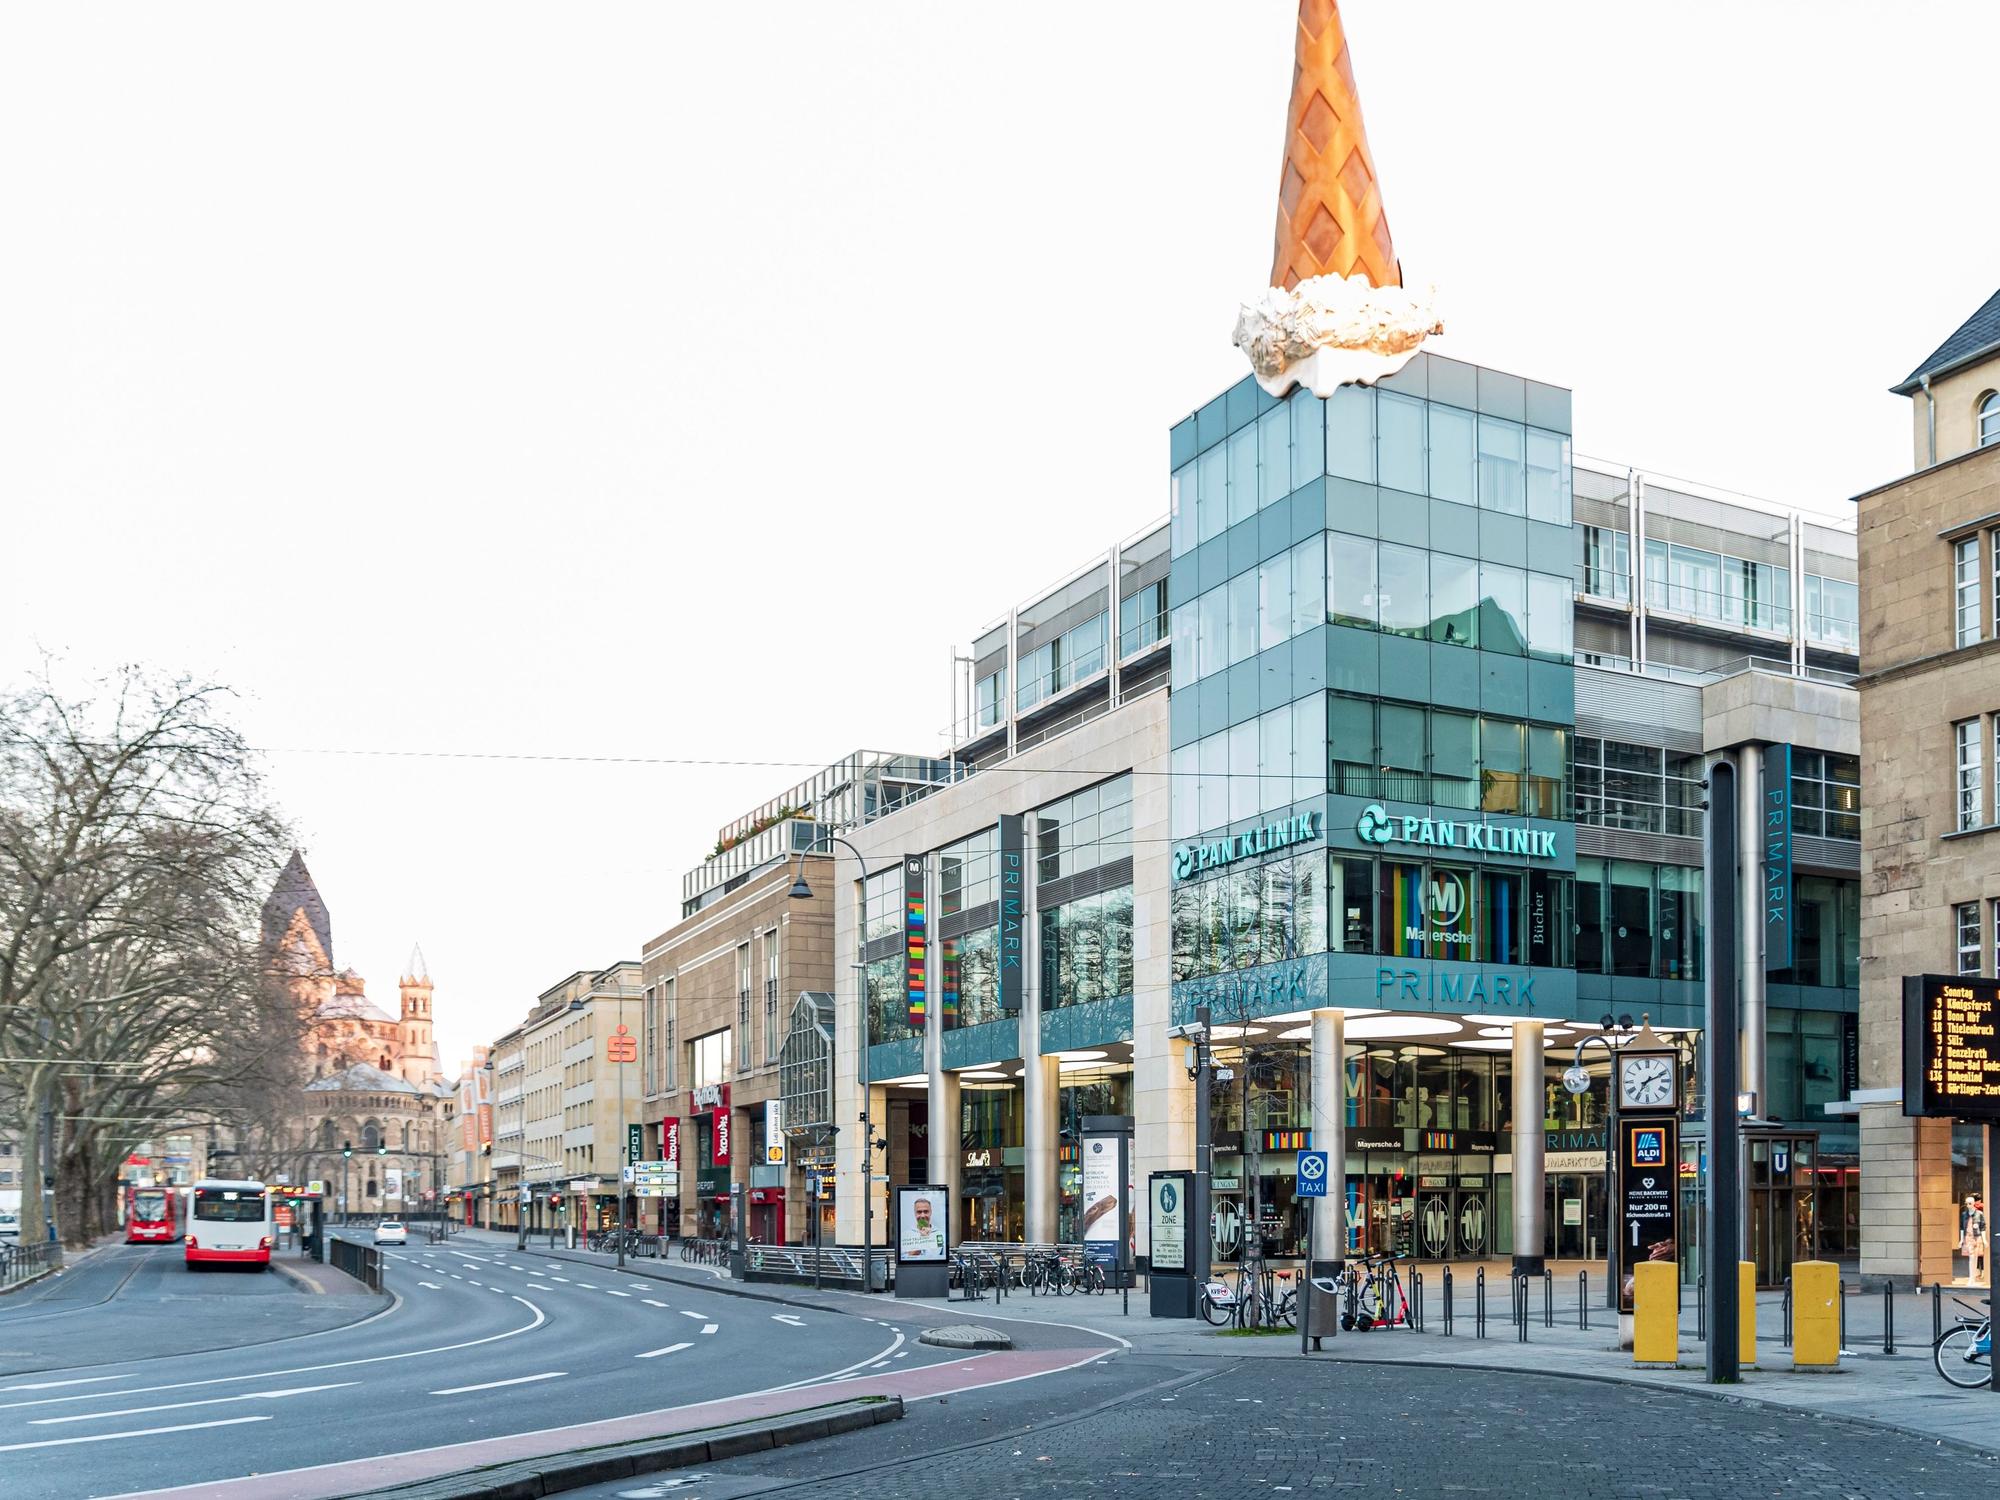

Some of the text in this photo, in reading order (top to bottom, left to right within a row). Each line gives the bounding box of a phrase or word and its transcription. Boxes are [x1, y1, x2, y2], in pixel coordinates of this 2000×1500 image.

[1196, 810, 1317, 870] PAN KLINIK
[1403, 814, 1558, 858] PAN KLINIK
[1768, 790, 1785, 925] PRIMARK
[909, 862, 919, 872] M
[1429, 880, 1457, 913] M
[1003, 853, 1019, 969] PRIMARK
[1533, 891, 1545, 945] Bücher
[1405, 926, 1475, 944] Maersche
[1188, 968, 1306, 1008] PRIMARK
[1376, 966, 1537, 1007] PRIMARK
[1943, 985, 1974, 999] Sonntag
[1937, 997, 1991, 1012] 9 Königsforst
[1932, 1009, 1981, 1023] 18 Bonn Hbf
[1932, 1021, 1994, 1036] 18 Thielenbruch
[1937, 1034, 1964, 1046] 9 Sülz
[1847, 1031, 1856, 1088] nderwelt
[1937, 1046, 1988, 1059] 7 Benzelrath
[1933, 1058, 1943, 1069] 16
[1947, 1058, 1981, 1070] Bonn-Bad
[1929, 1070, 1983, 1083] 136 Hohenlind
[1936, 1082, 1943, 1094] 3
[631, 1128, 640, 1160] EPOT
[1357, 1140, 1401, 1149] Mayersche.de
[1547, 1132, 1607, 1149] RIMA
[1213, 1145, 1238, 1153] ayersche.de
[1637, 1149, 1660, 1157] ALDI
[1774, 1154, 1787, 1172] U
[1300, 1182, 1324, 1193] TAXI
[1161, 1215, 1177, 1224] ZONE
[1215, 1212, 1235, 1243] M
[1426, 1210, 1445, 1242] M
